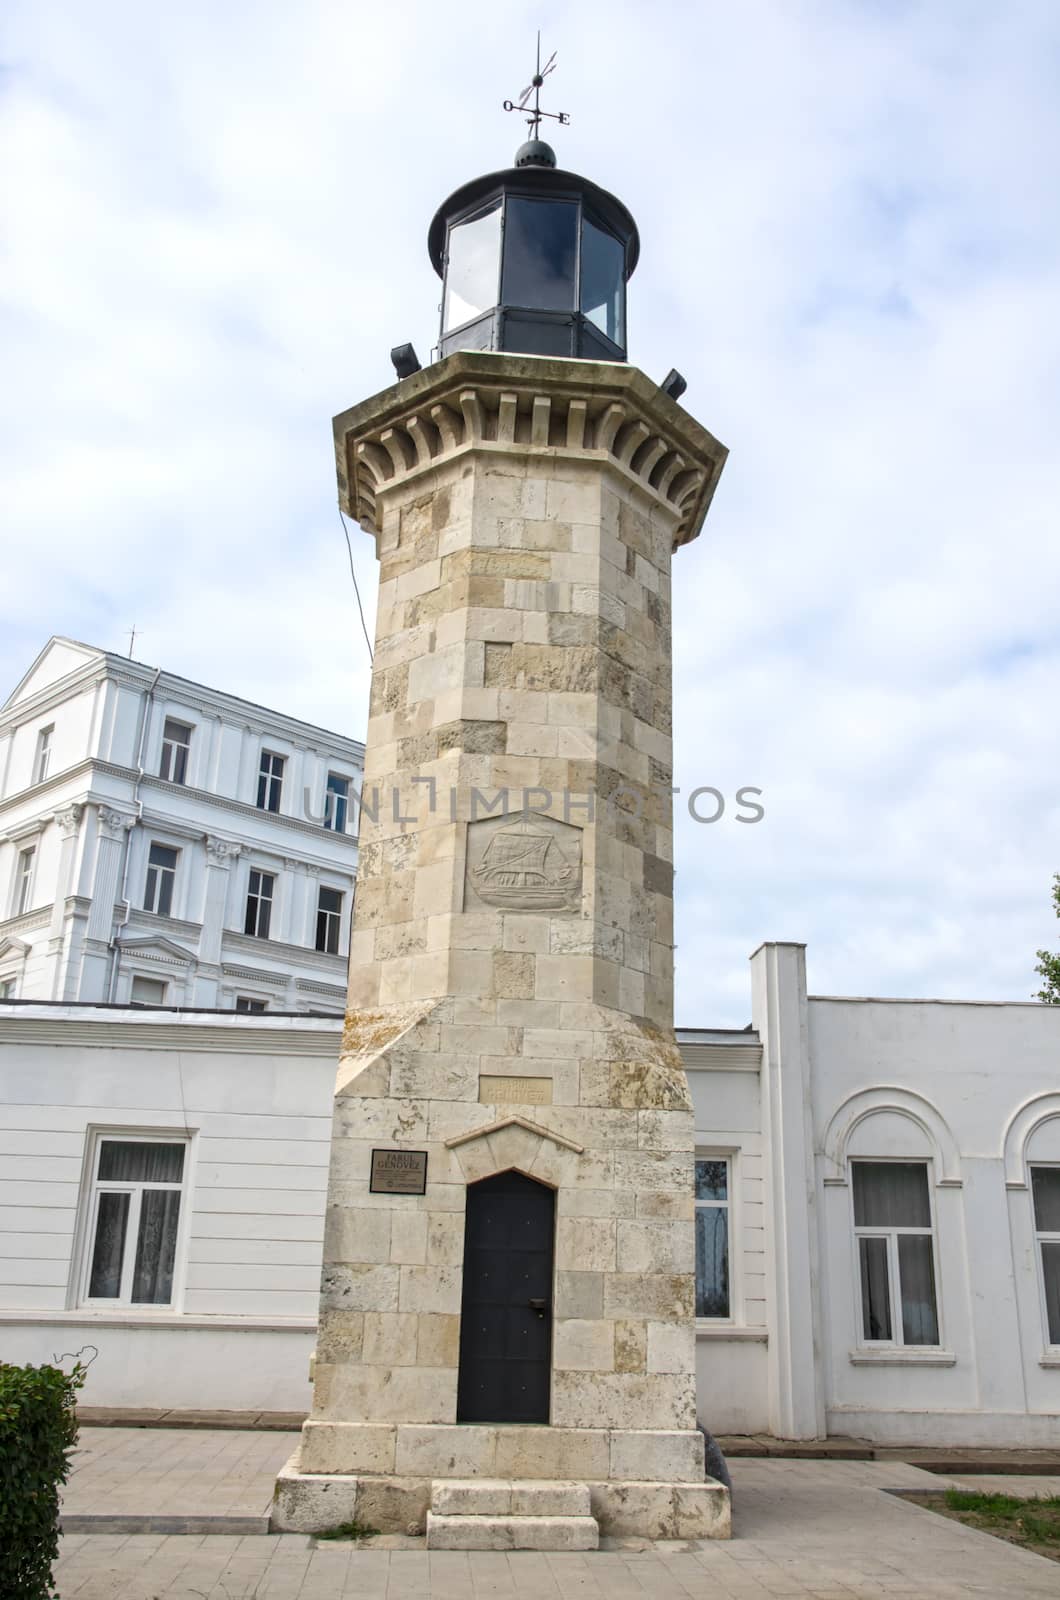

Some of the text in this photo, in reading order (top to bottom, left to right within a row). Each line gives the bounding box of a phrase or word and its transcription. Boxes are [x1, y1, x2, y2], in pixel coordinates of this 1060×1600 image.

[558, 112, 570, 126] E
[386, 1153, 416, 1162] FARUL
[377, 1160, 421, 1170] GENOVEZ
